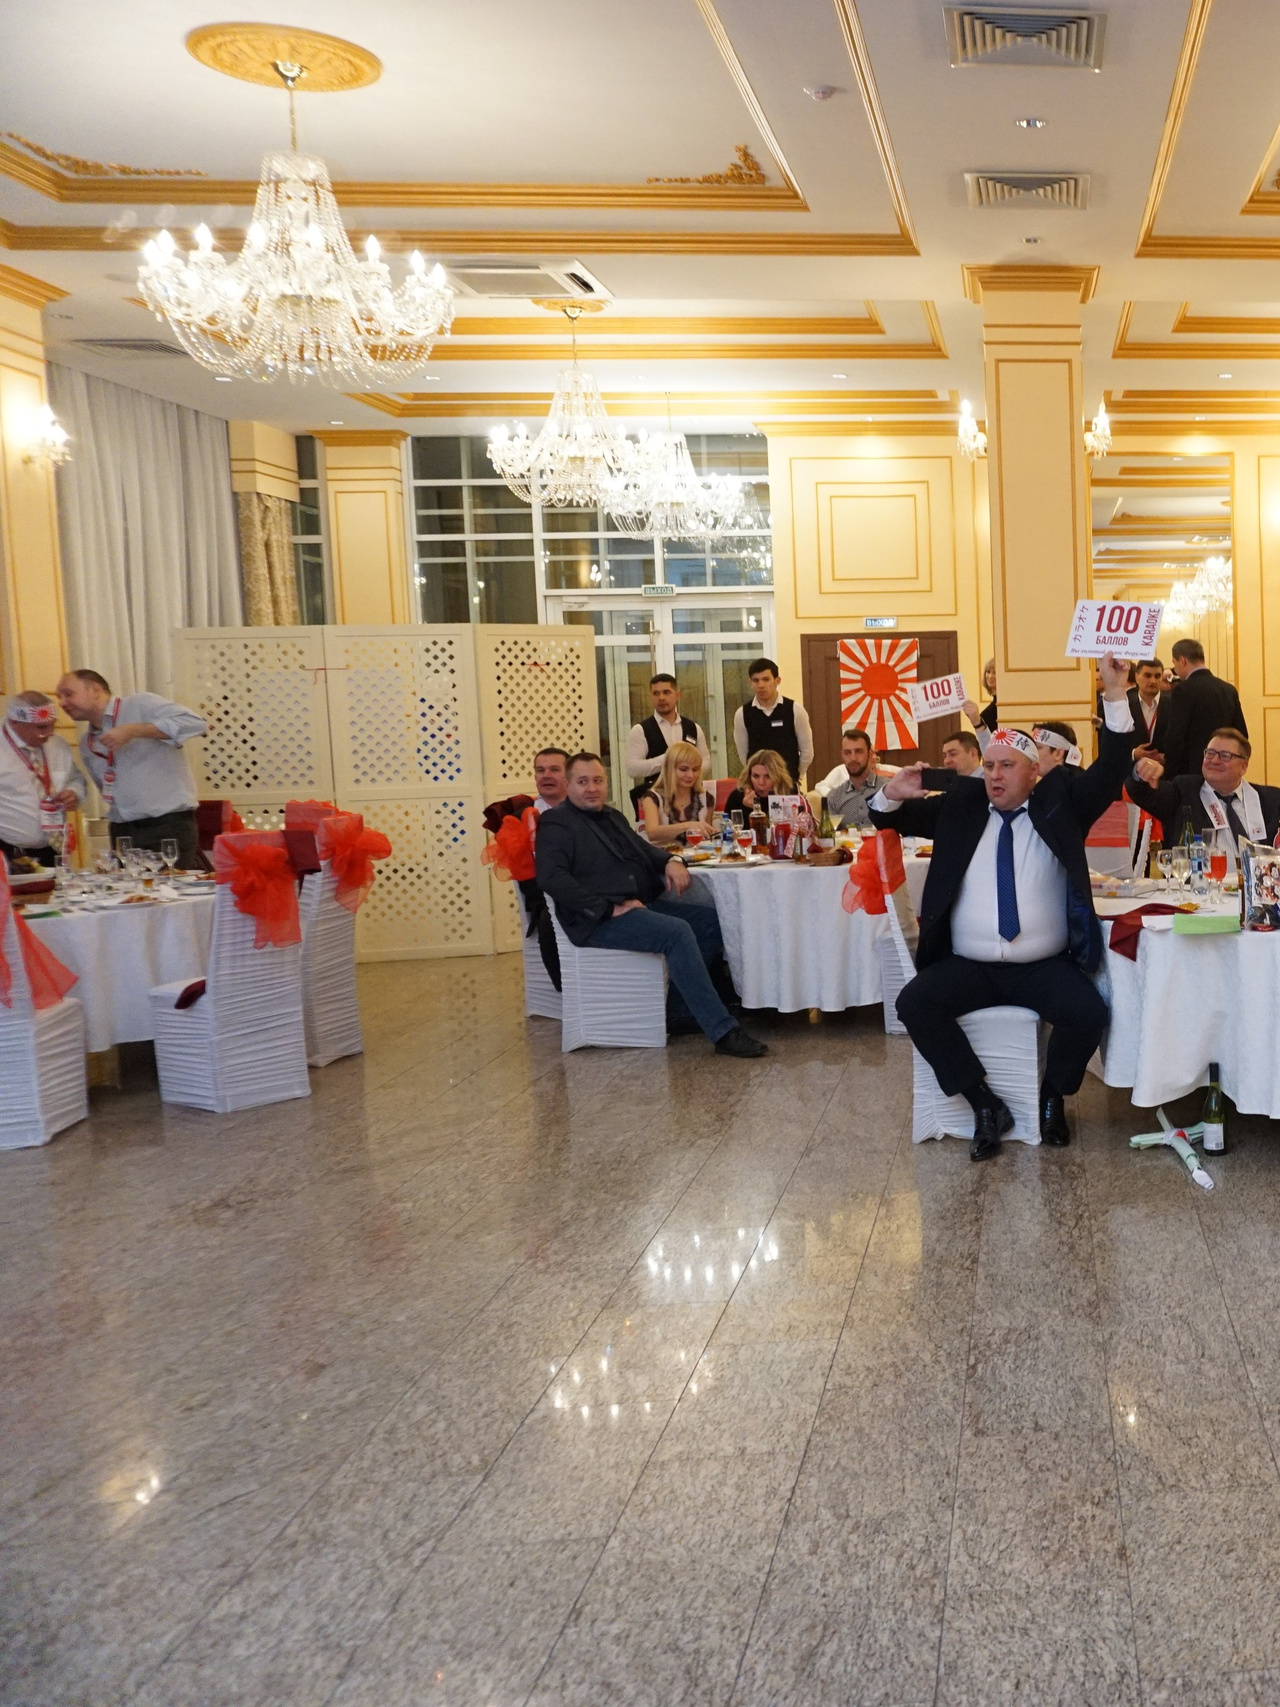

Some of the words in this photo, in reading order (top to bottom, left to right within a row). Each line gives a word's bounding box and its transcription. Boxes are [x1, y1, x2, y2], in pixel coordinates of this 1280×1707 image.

[645, 587, 673, 595] ВЫХОД
[1072, 604, 1089, 643] カラオケ
[1095, 604, 1142, 634] 100
[1141, 607, 1161, 647] KARAOKE
[1095, 635, 1129, 646] БАЛЛОВ
[921, 678, 952, 702] 100
